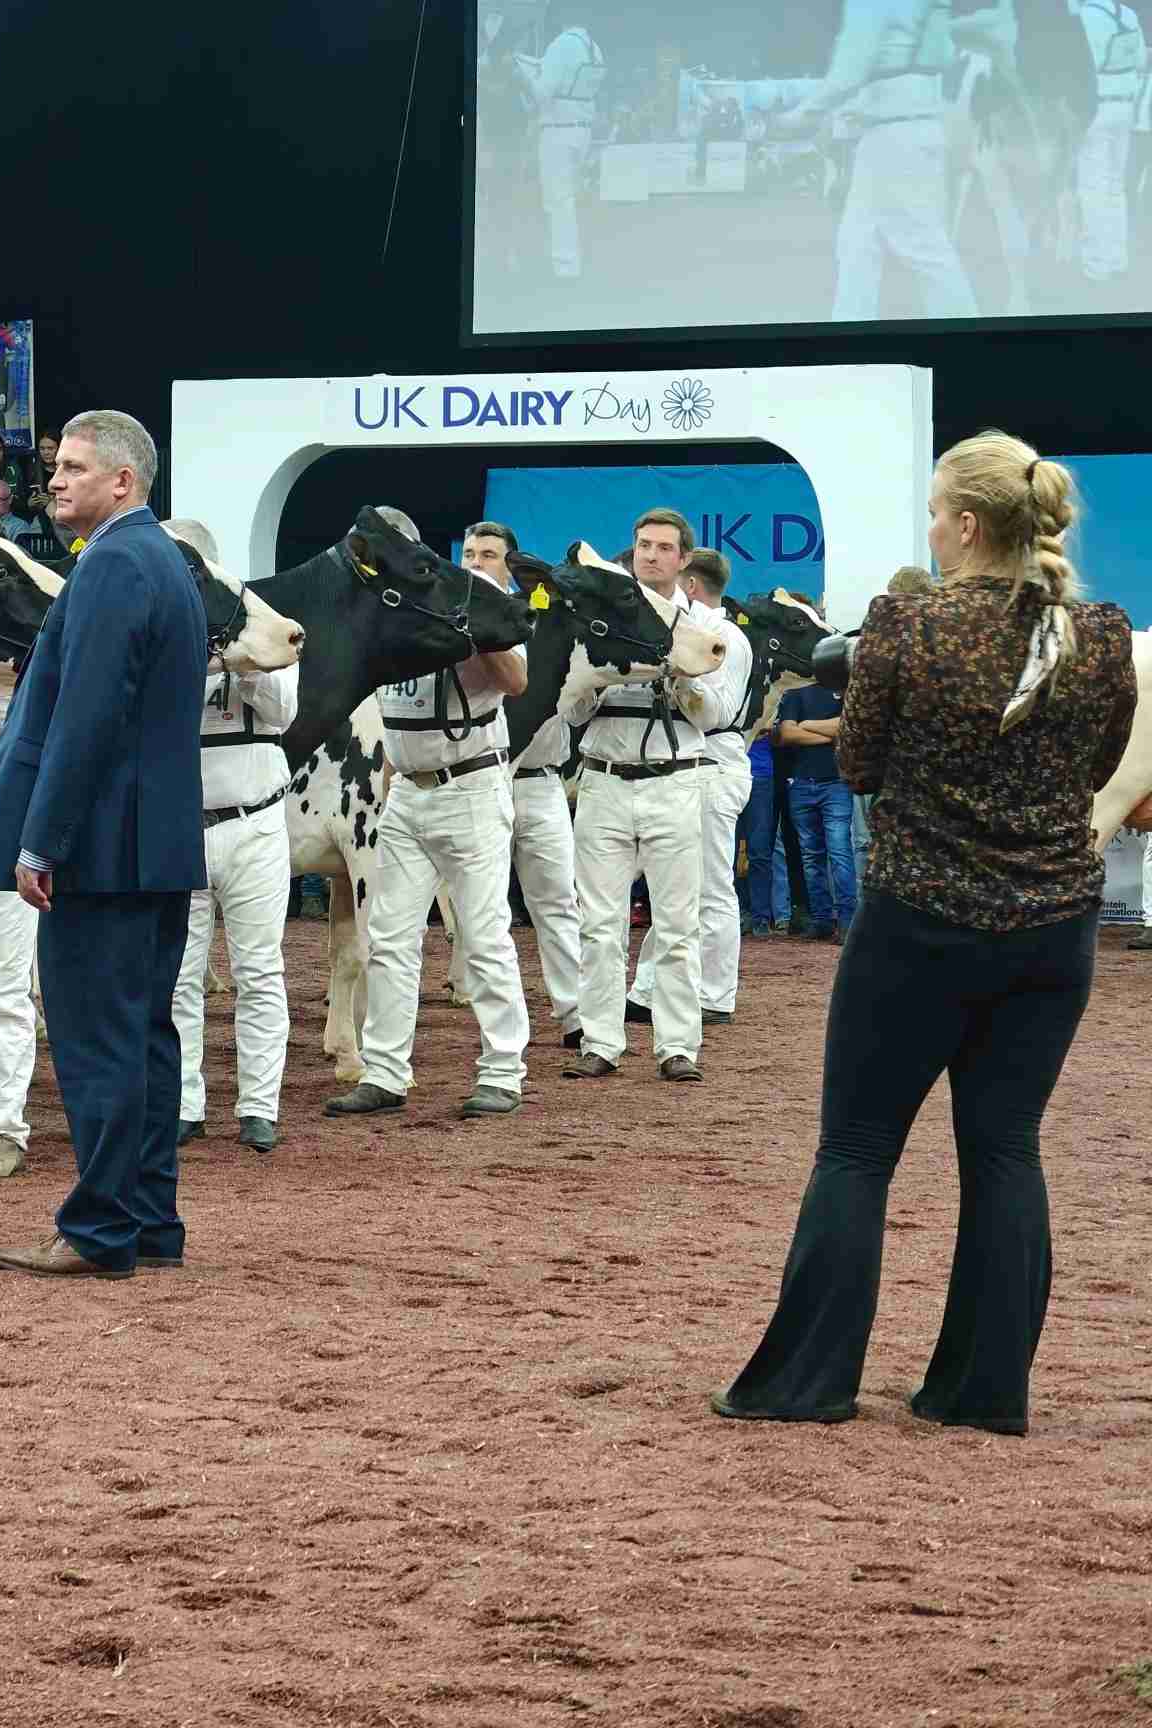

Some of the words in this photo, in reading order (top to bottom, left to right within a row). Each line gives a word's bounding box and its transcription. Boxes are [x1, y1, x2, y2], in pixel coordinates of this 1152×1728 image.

[355, 386, 429, 429] UK
[442, 386, 575, 429] DAIRY
[582, 381, 651, 433] Day
